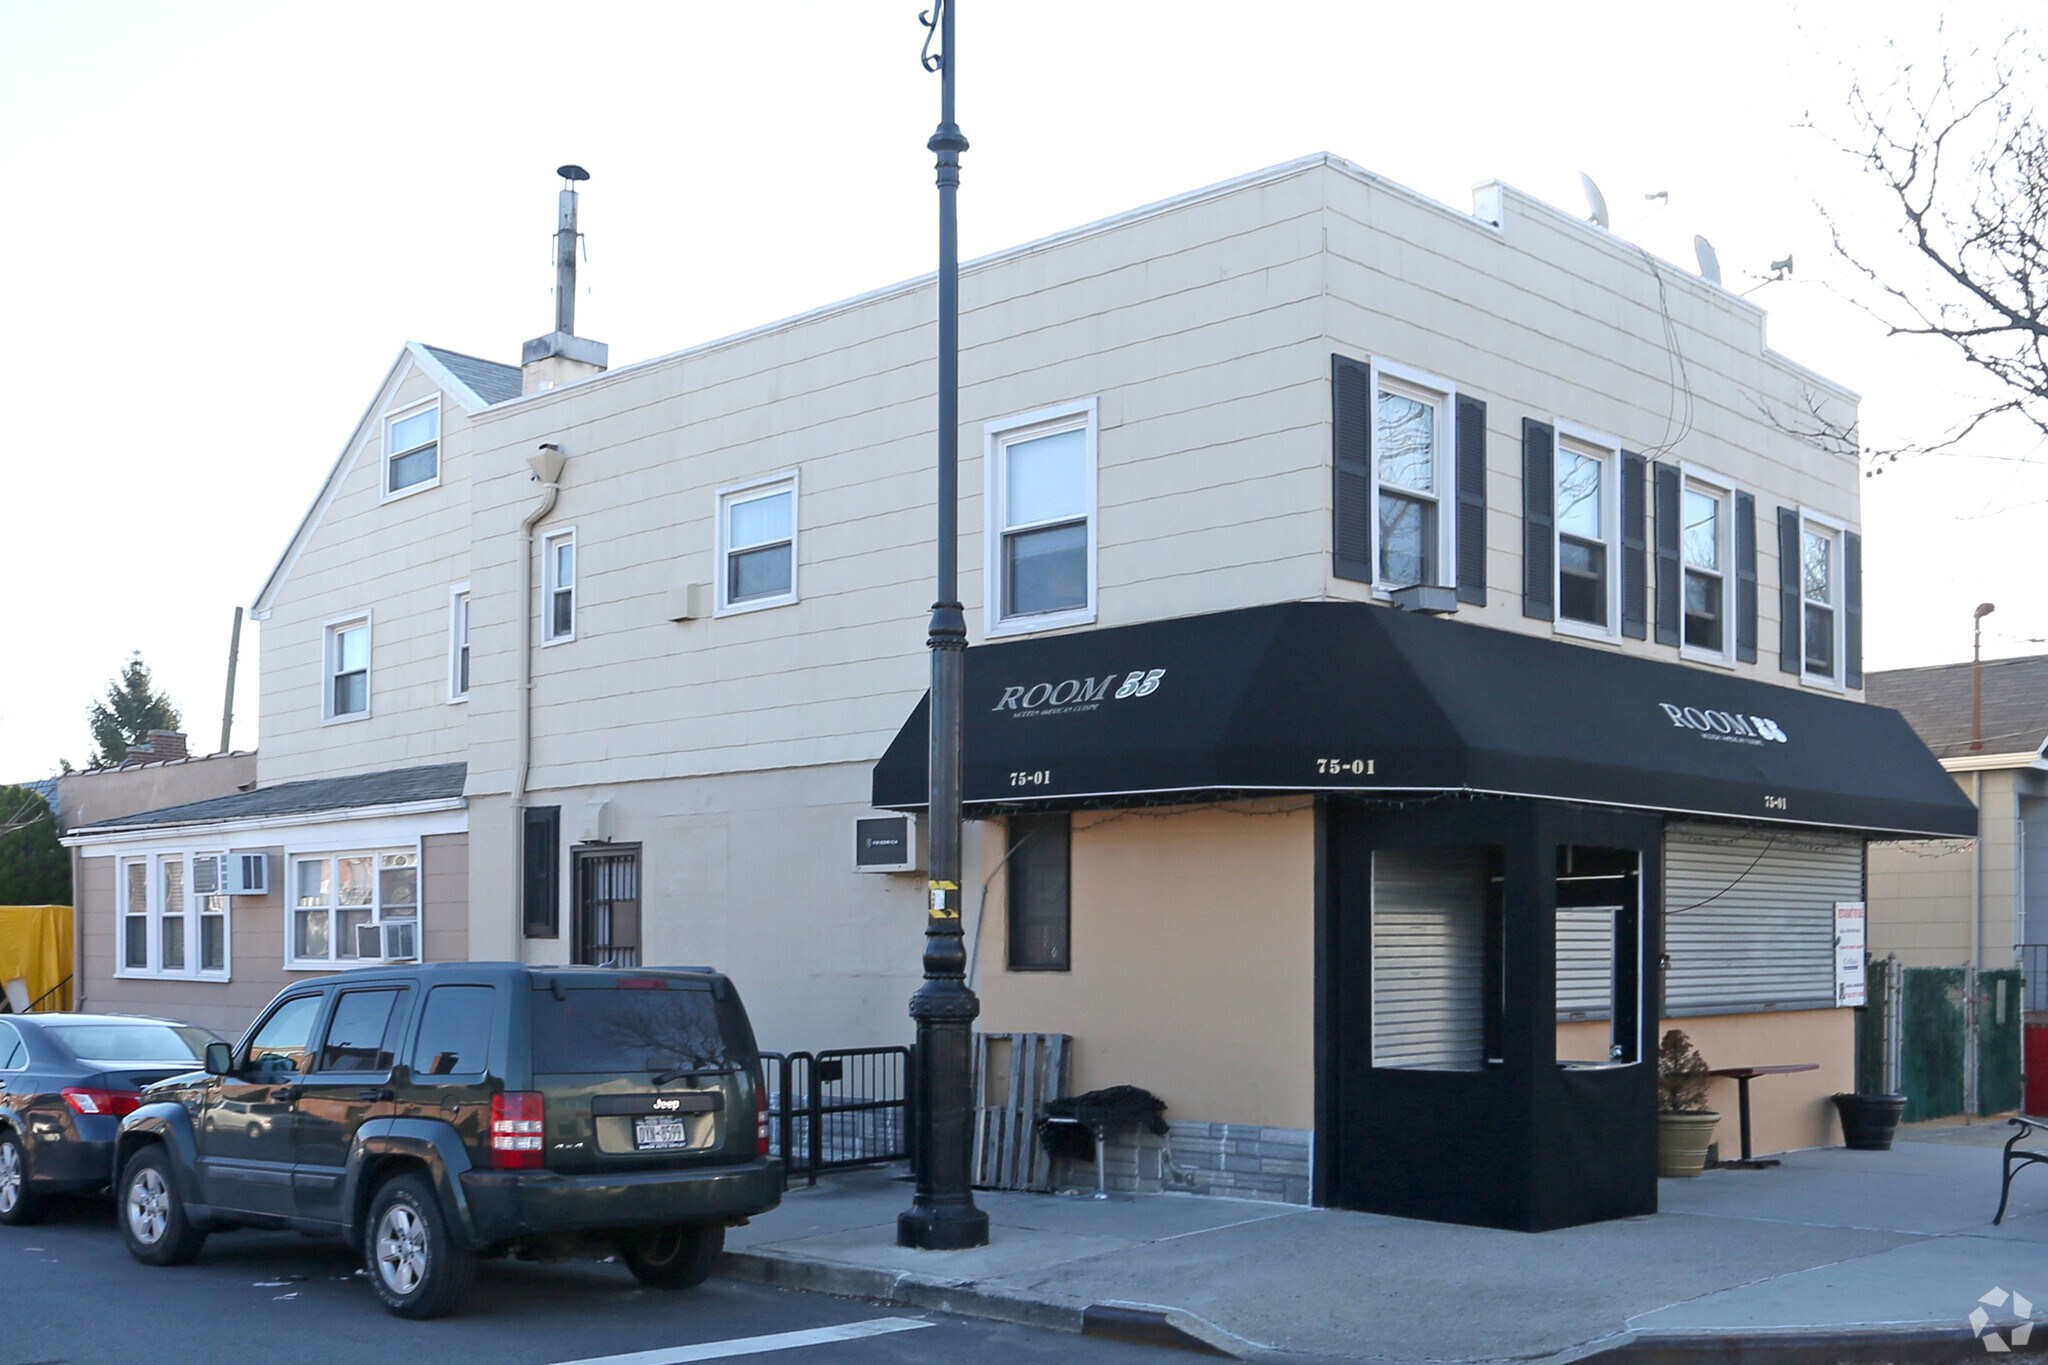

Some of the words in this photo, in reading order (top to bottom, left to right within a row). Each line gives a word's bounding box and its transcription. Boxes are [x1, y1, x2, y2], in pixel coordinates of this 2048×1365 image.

[992, 674, 1117, 711] ROOM
[1115, 668, 1166, 699] 55
[1658, 702, 1757, 737] ROOM
[1316, 758, 1375, 775] 75-01
[1010, 770, 1051, 786] 75-01
[653, 1098, 680, 1112] Jeep
